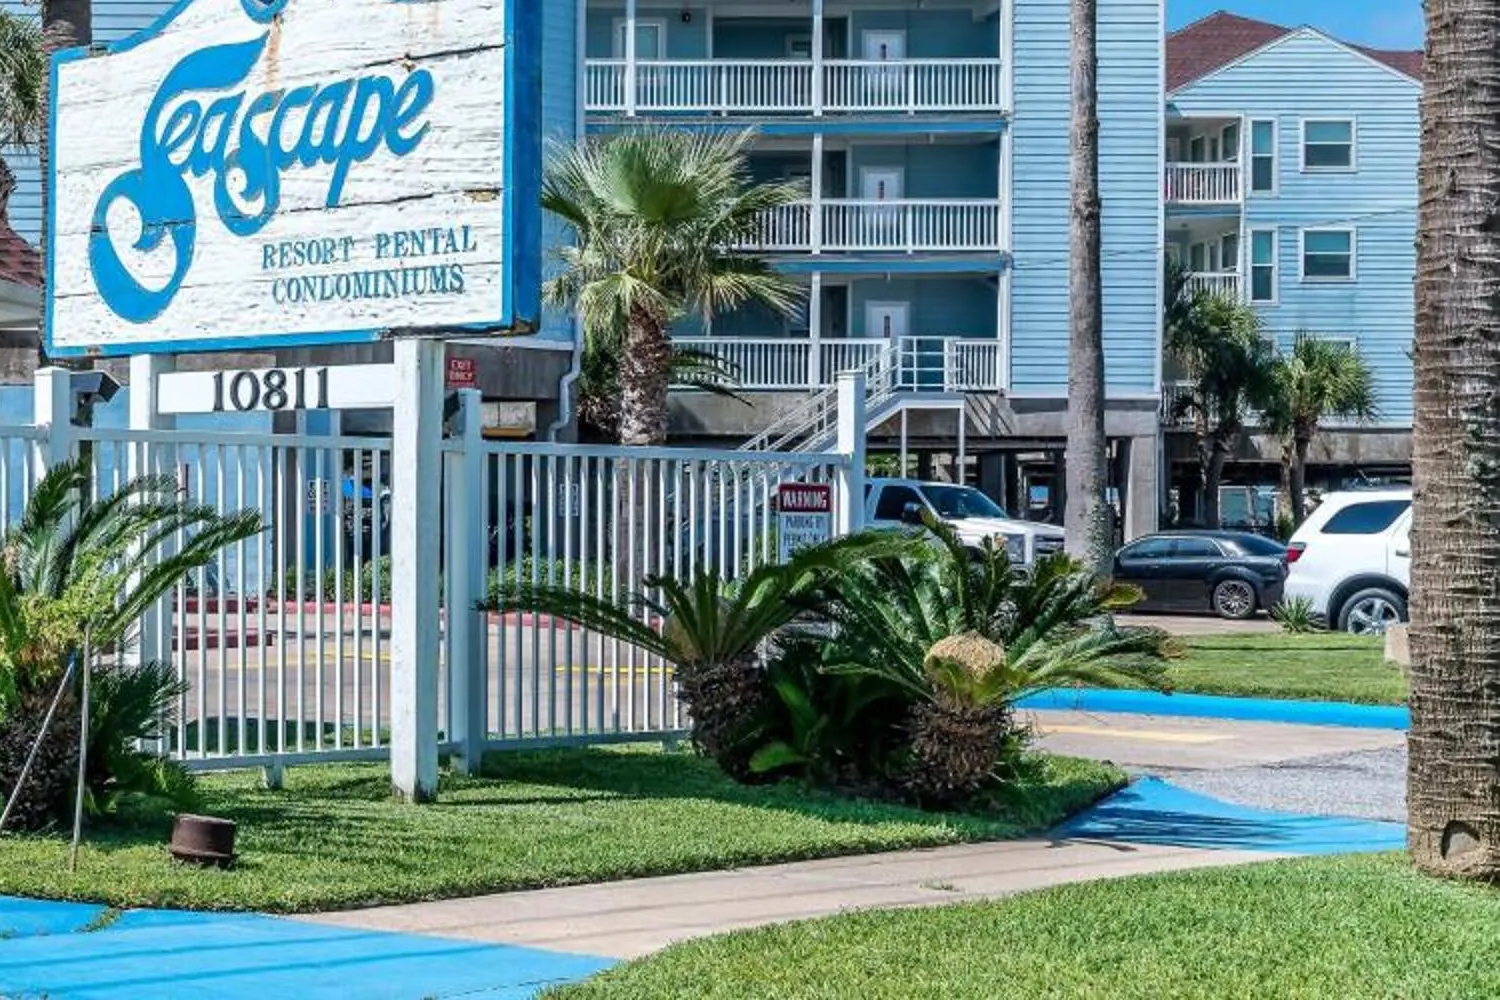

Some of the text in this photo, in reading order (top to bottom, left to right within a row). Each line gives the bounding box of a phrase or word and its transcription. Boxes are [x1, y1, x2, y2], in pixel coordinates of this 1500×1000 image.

[89, 30, 434, 323] Seascape
[261, 225, 477, 270] RESORT RENTAL
[272, 263, 466, 304] CONDOMINIUMS
[451, 359, 471, 370] EXIT
[213, 367, 328, 411] 10811
[782, 491, 827, 509] WARNING
